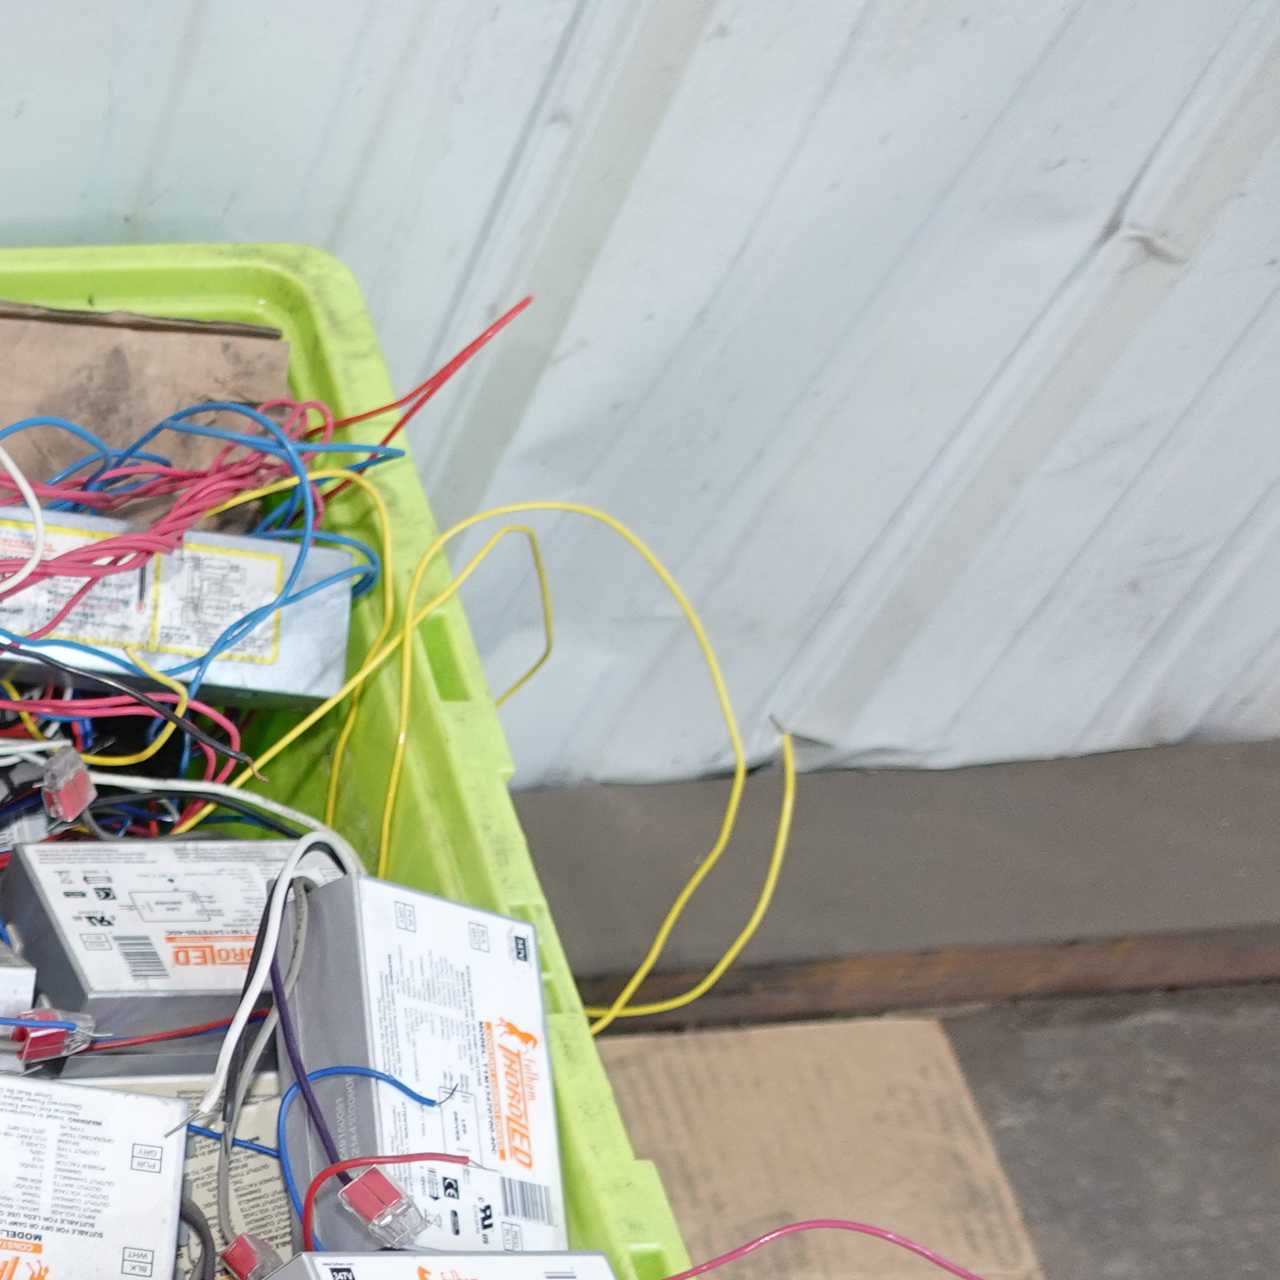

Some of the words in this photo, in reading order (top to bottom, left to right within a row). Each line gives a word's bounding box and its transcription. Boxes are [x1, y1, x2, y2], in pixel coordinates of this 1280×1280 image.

[137, 1147, 157, 1157] GRY
[136, 1159, 155, 1169] PUR
[0, 1228, 42, 1240] MODEL:
[126, 1250, 147, 1259] WHT
[129, 1263, 146, 1272] BLK
